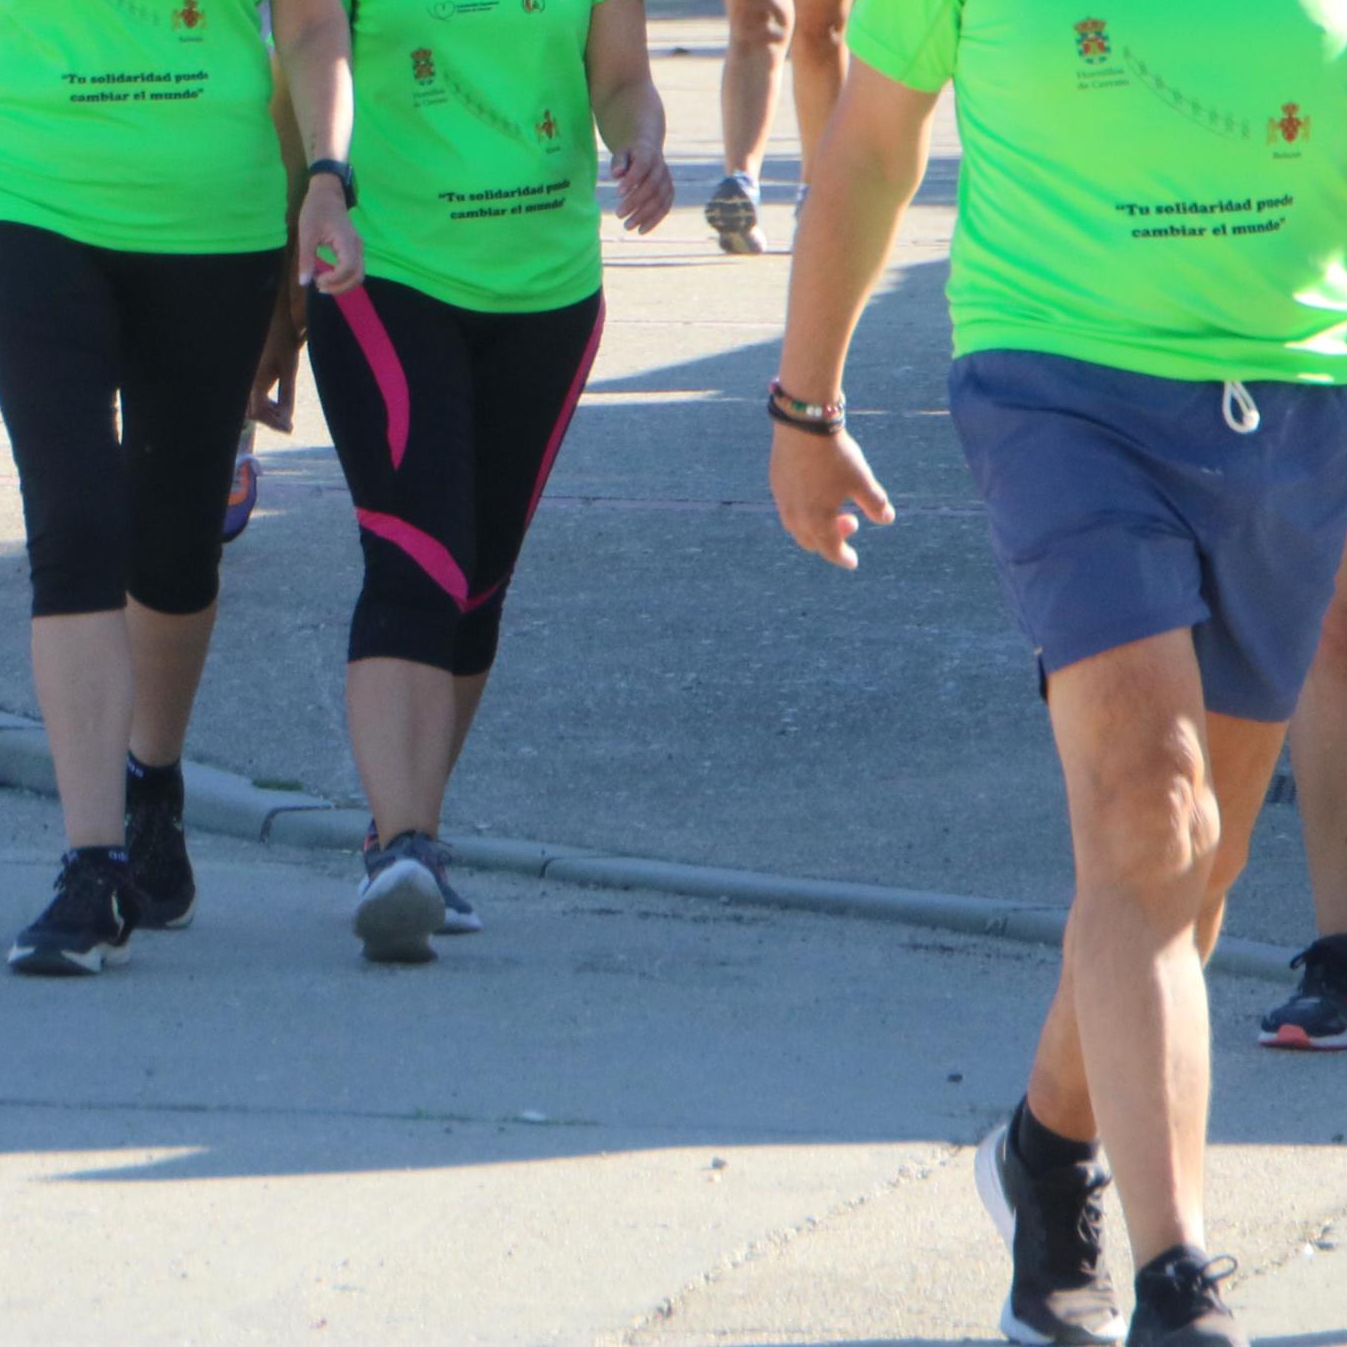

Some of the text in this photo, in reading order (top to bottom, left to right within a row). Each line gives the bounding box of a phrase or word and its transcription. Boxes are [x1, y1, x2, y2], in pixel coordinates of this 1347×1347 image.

[90, 72, 171, 85] solidaridad
[70, 90, 129, 103] cambiar
[133, 89, 146, 102] el
[469, 185, 544, 202] solidaridad
[450, 205, 508, 220] cambiar
[510, 203, 522, 215] el
[1155, 199, 1252, 216] solidaridad
[1131, 223, 1207, 239] cambiar
[1212, 222, 1228, 237] el
